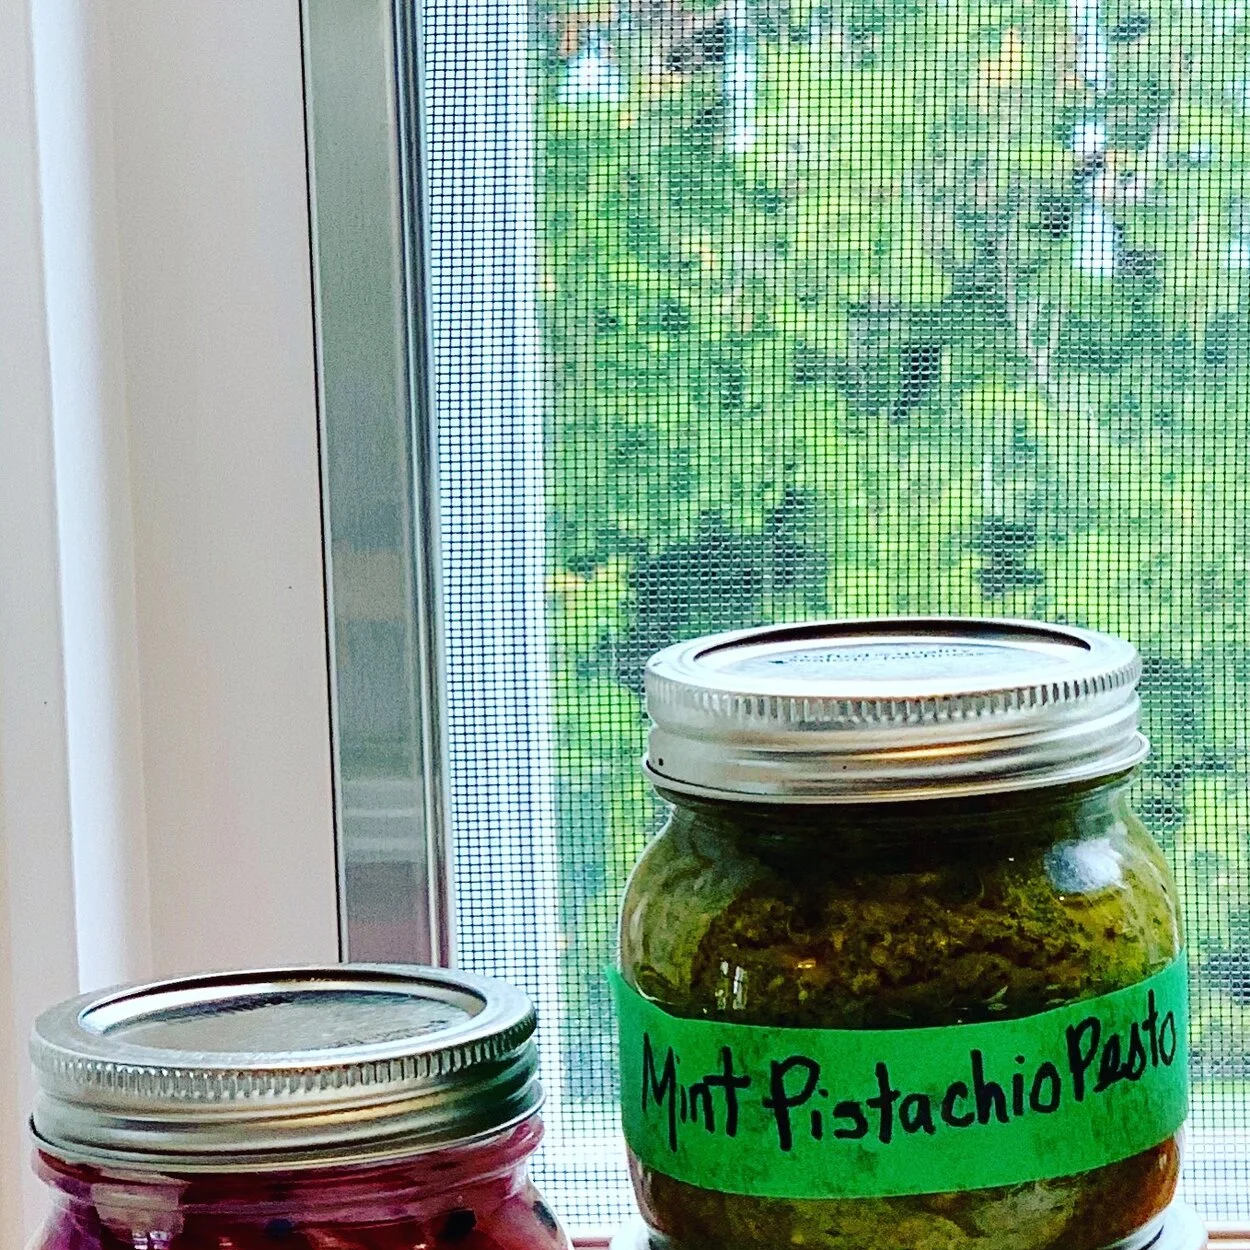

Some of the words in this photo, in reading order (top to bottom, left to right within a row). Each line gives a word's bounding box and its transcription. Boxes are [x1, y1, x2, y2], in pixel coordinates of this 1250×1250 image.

[641, 1032, 751, 1153] Mint
[763, 1048, 1061, 1152] Pistachio
[1065, 989, 1177, 1103] Pesto
